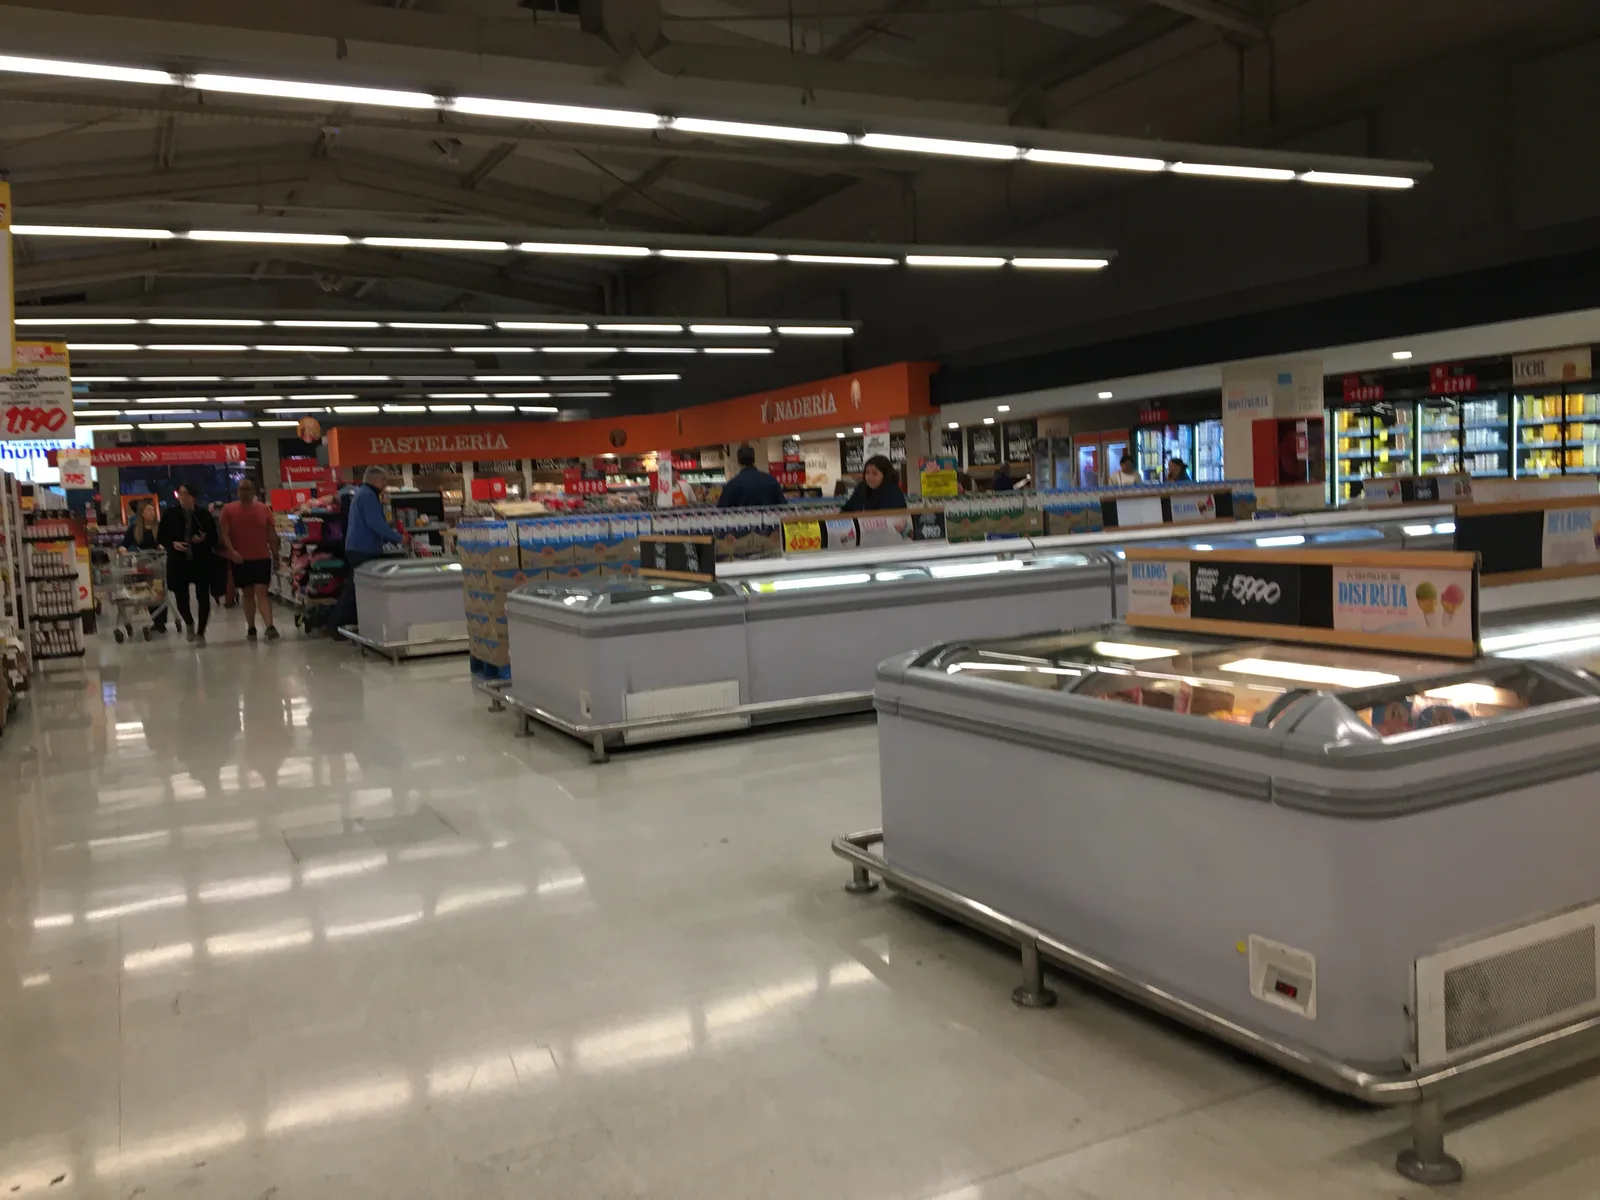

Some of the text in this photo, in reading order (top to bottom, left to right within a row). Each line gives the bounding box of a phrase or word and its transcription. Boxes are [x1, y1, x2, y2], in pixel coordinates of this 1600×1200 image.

[369, 430, 510, 455] PASTELERÍA
[1131, 563, 1168, 580] HELADOS
[1338, 581, 1408, 608] DISFRUTA
